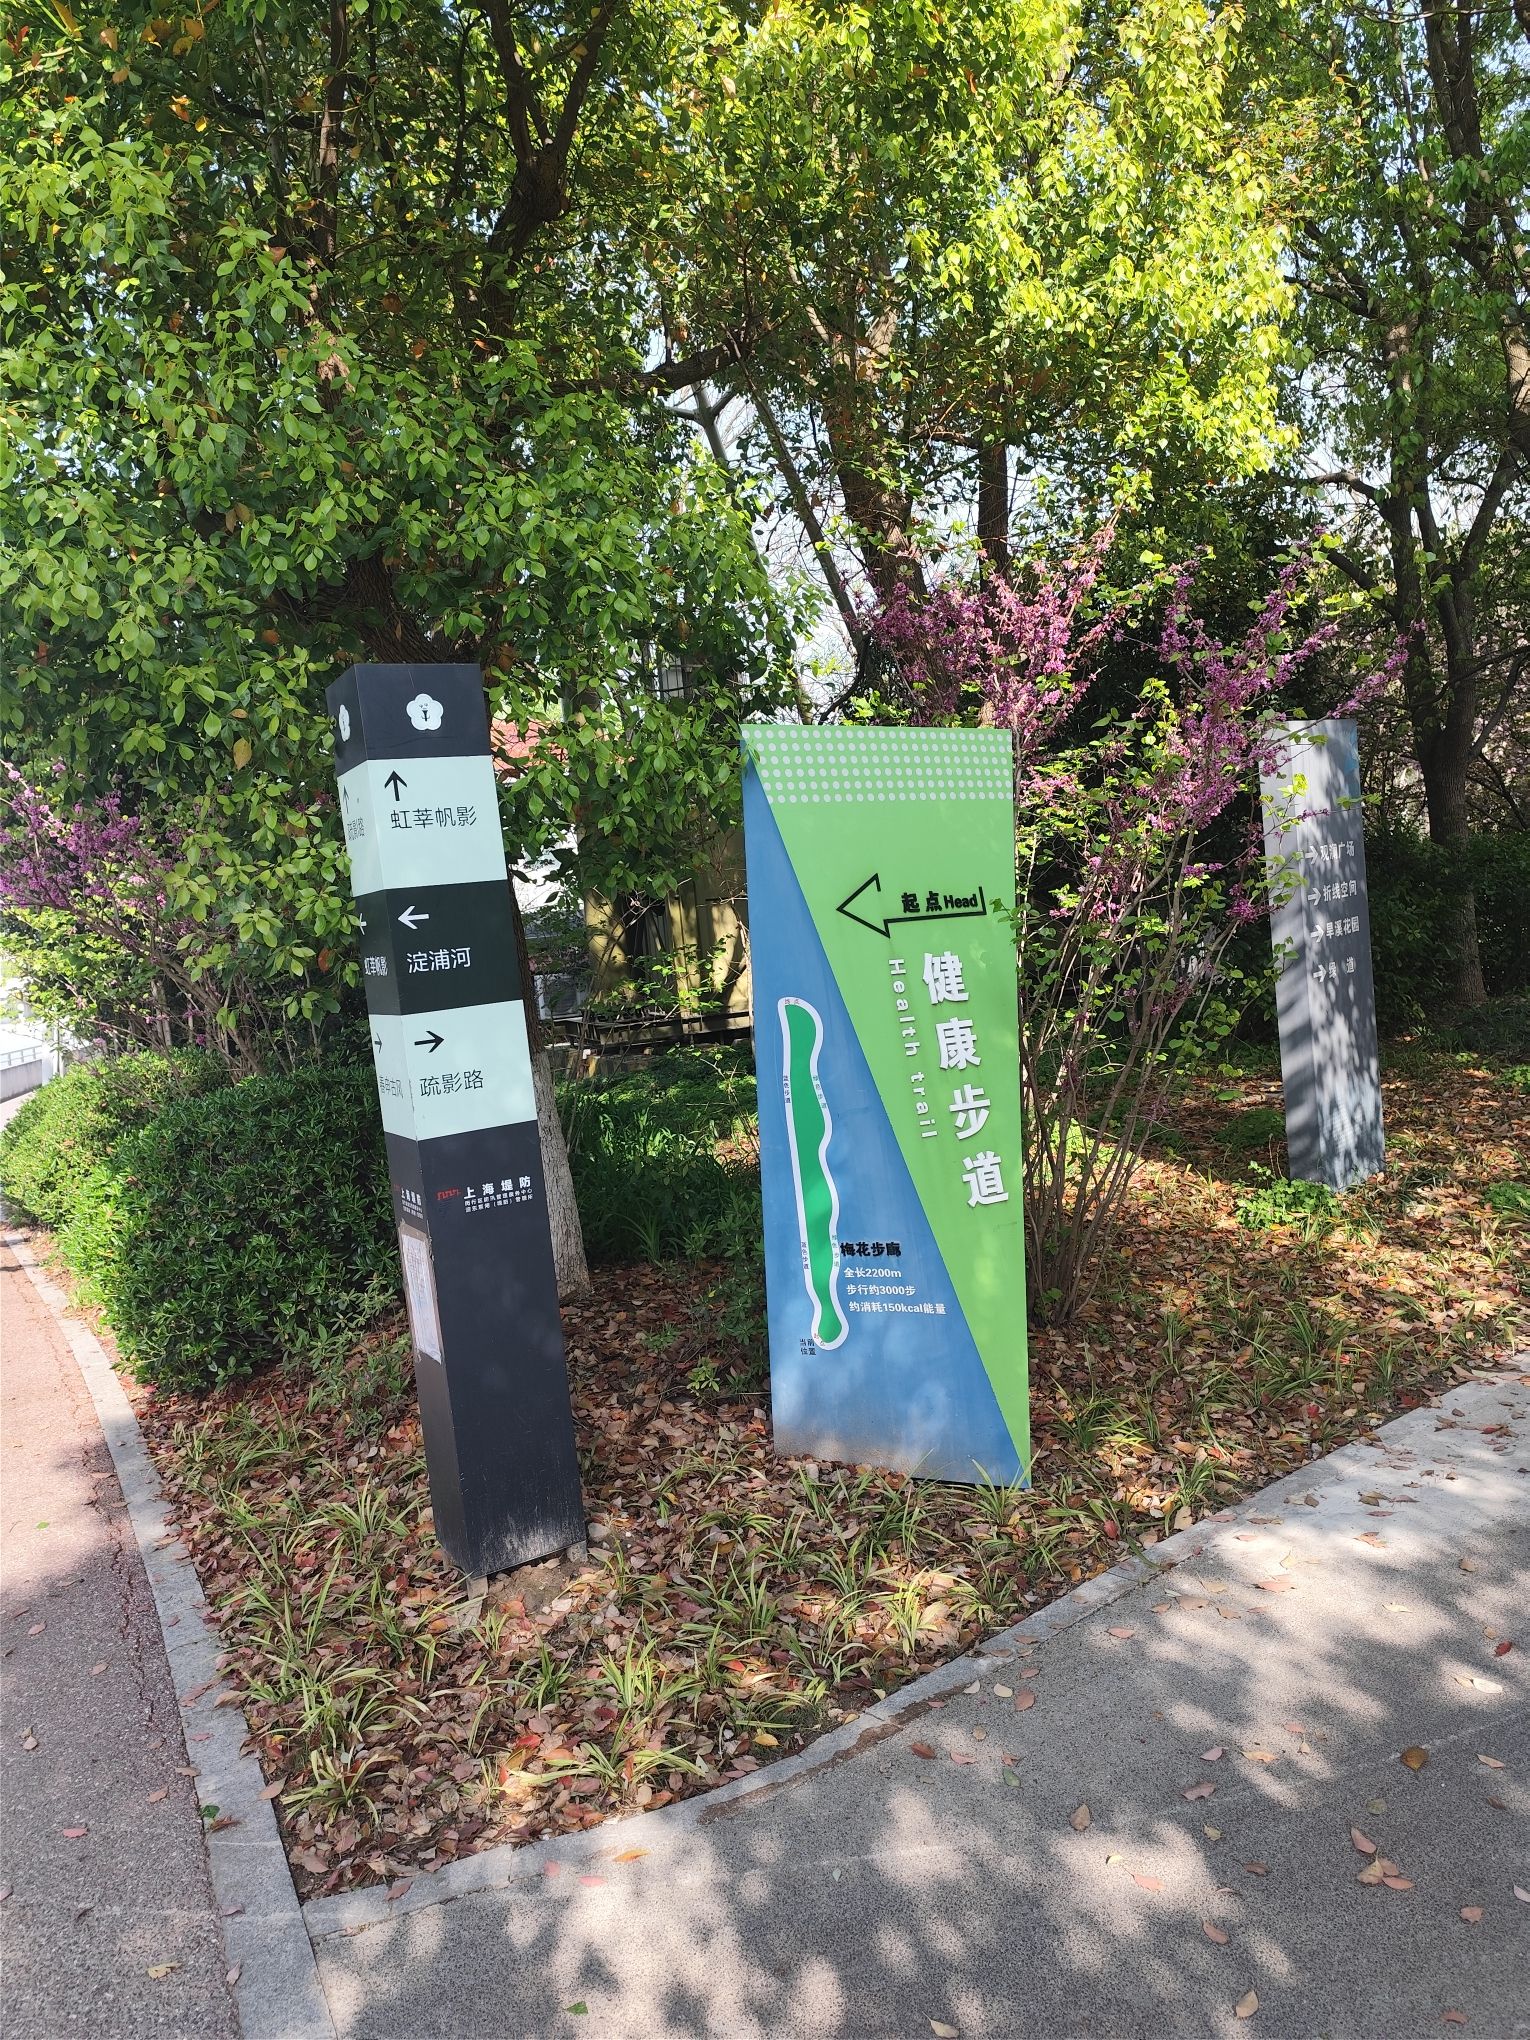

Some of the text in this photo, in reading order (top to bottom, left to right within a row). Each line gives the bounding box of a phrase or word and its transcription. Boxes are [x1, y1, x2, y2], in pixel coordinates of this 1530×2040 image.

[390, 806, 477, 829] 虹莘帆影
[1323, 880, 1357, 902] 折线空间
[1326, 916, 1360, 939] 旱溪花园
[406, 947, 471, 974] 淀浦河
[889, 958, 939, 1138] Health trail
[419, 1069, 484, 1097] 疏影路
[922, 951, 1009, 1208] 健康步道
[463, 1175, 532, 1200] 上海堤防
[840, 1241, 901, 1257] 梅花步廊
[844, 1267, 902, 1278] 全长2200m
[846, 1284, 916, 1296] 步行约3000步
[849, 1301, 947, 1315] 约消耗150kcal能量
